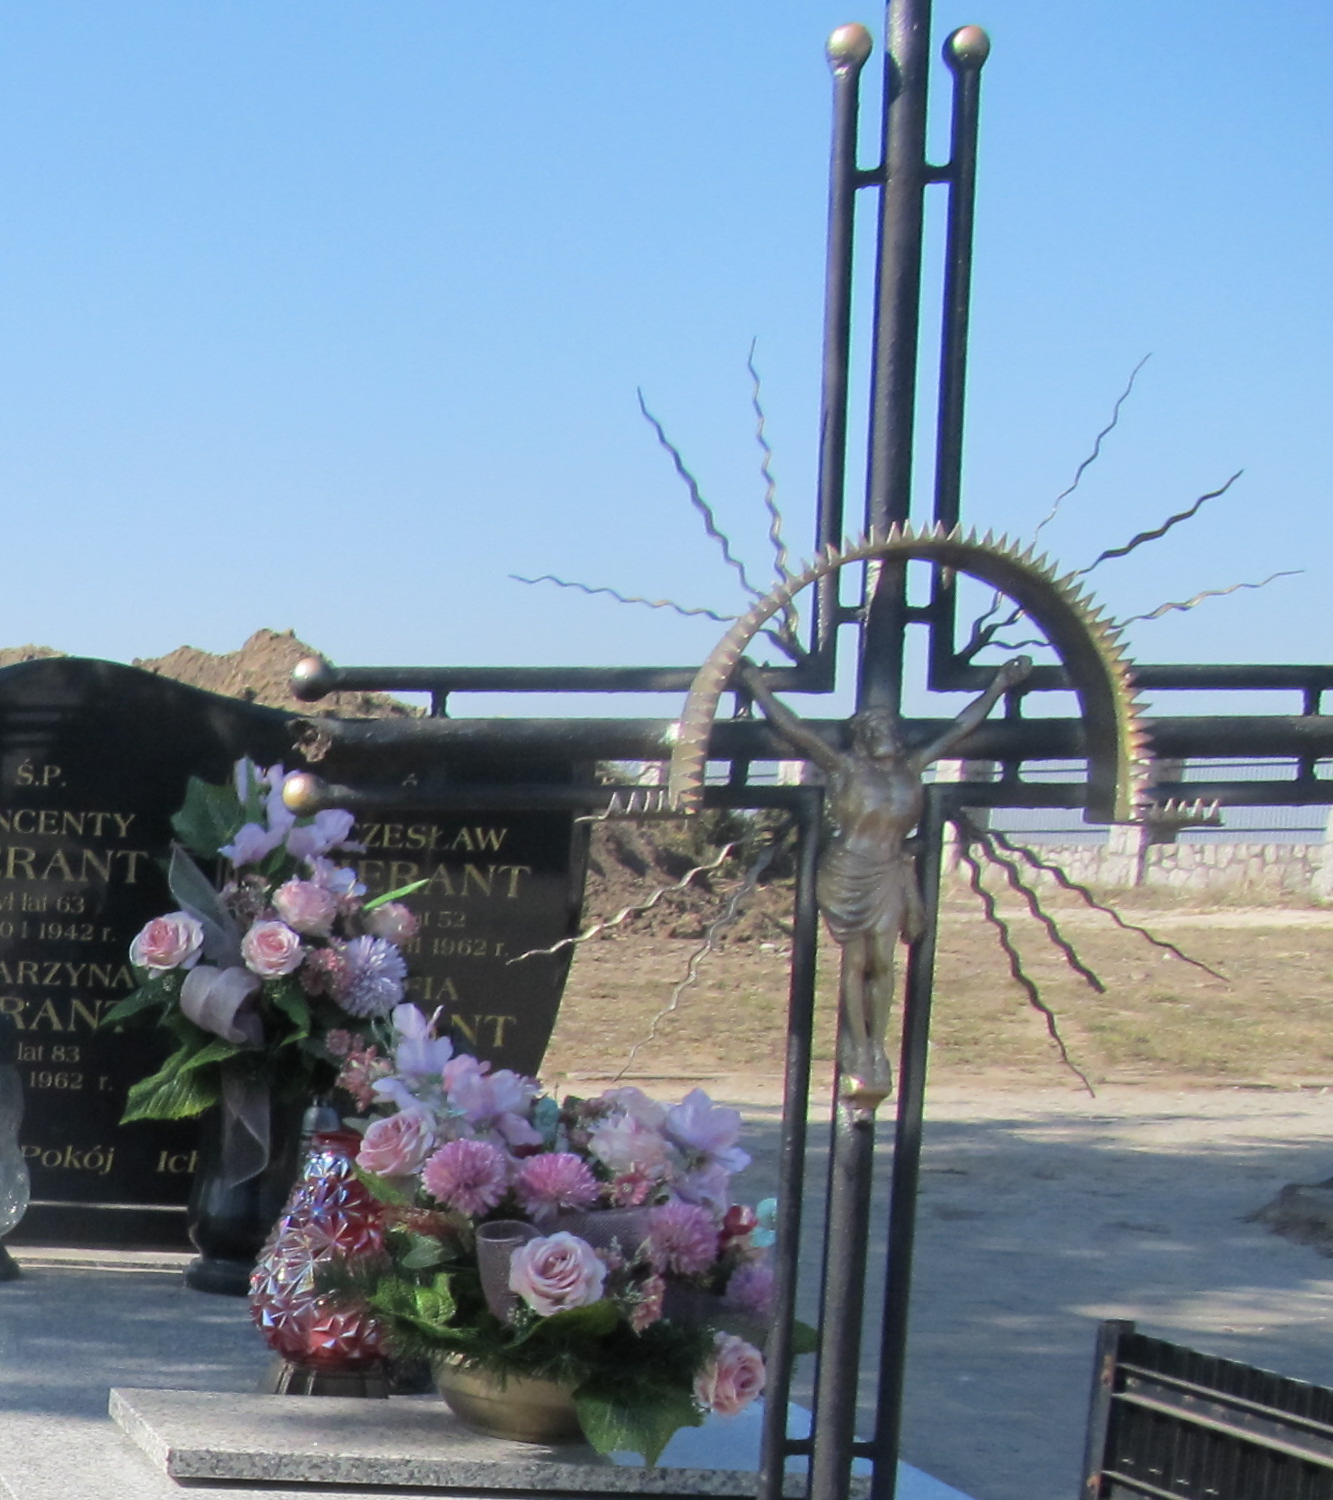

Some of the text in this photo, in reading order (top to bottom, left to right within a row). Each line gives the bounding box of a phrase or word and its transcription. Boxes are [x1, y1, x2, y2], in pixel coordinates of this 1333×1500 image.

[353, 823, 509, 852] ZESŁAW
[20, 892, 48, 913] lat
[55, 895, 86, 914] 63
[437, 910, 467, 929] 52
[38, 922, 95, 942] 1942
[432, 937, 488, 957] 1962
[17, 1042, 81, 1063] lat 83
[29, 1071, 83, 1091] 1962
[20, 1143, 117, 1175] Pokój
